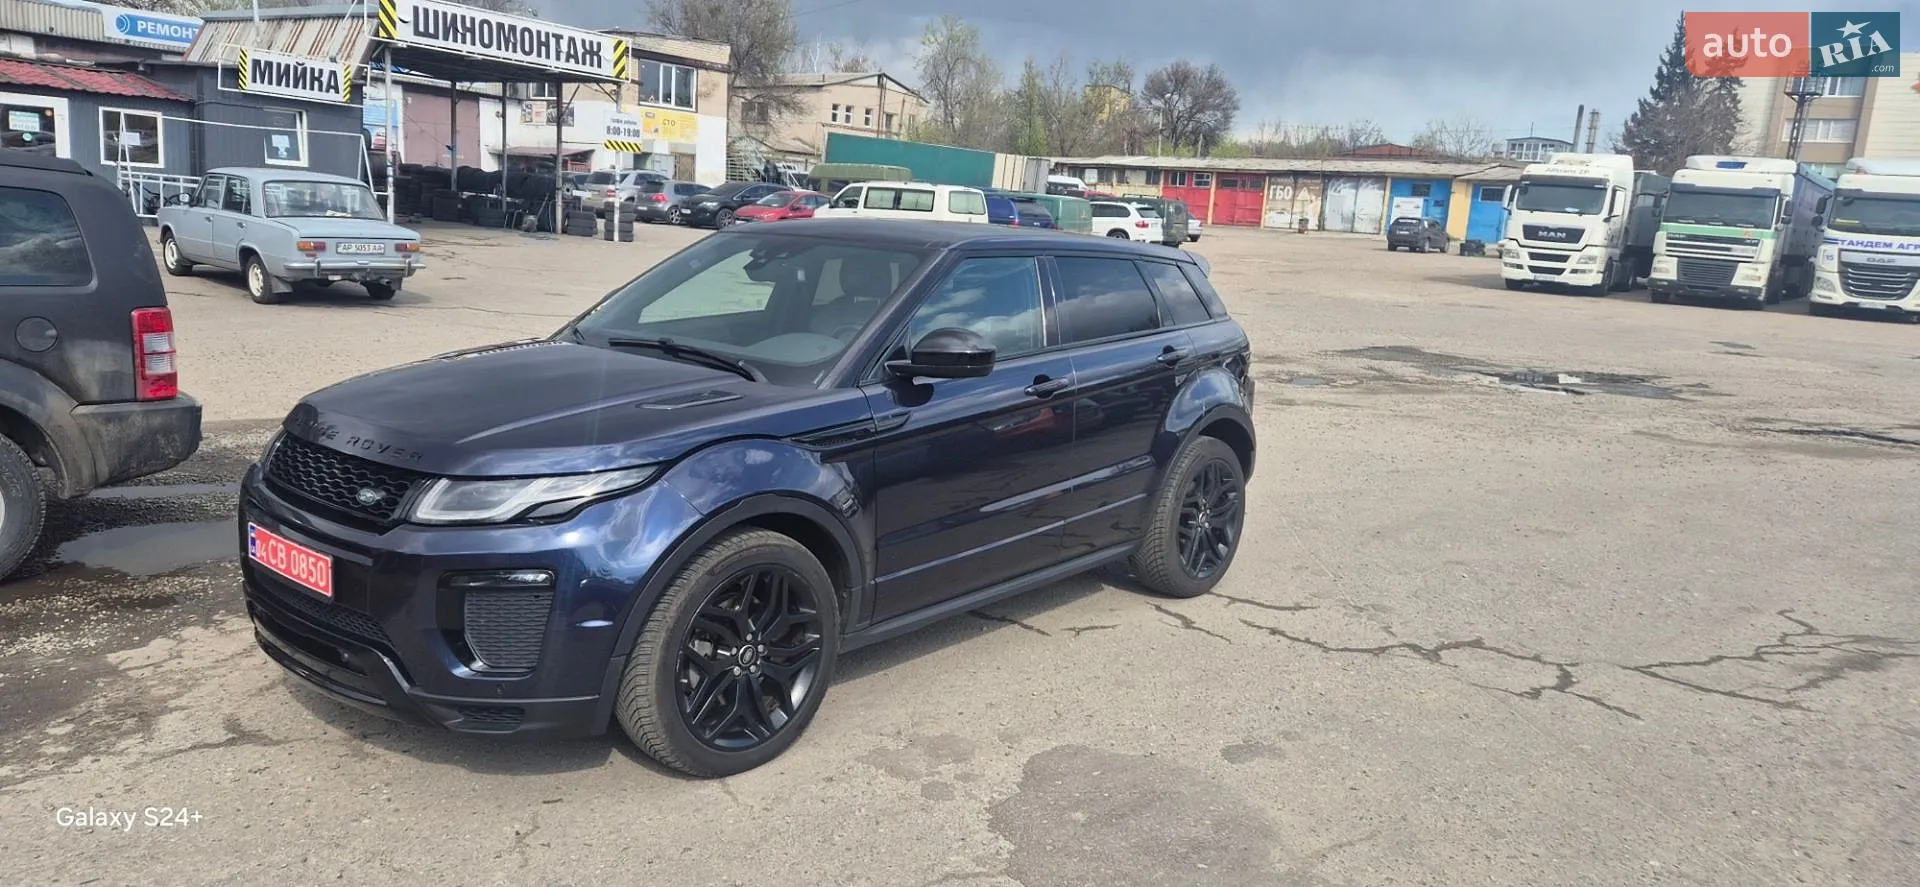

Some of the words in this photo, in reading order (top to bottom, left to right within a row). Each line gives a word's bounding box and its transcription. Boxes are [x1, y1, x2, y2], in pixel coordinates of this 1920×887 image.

[412, 5, 602, 68] ШИНОМОНТАЖ
[251, 58, 340, 95] МИЙКА
[606, 126, 640, 138] 8:00-19:00
[1269, 185, 1293, 201] ГБО
[1840, 239, 1893, 249] ТАНДЕМ
[268, 539, 286, 570] CB
[290, 550, 328, 587] 0850
